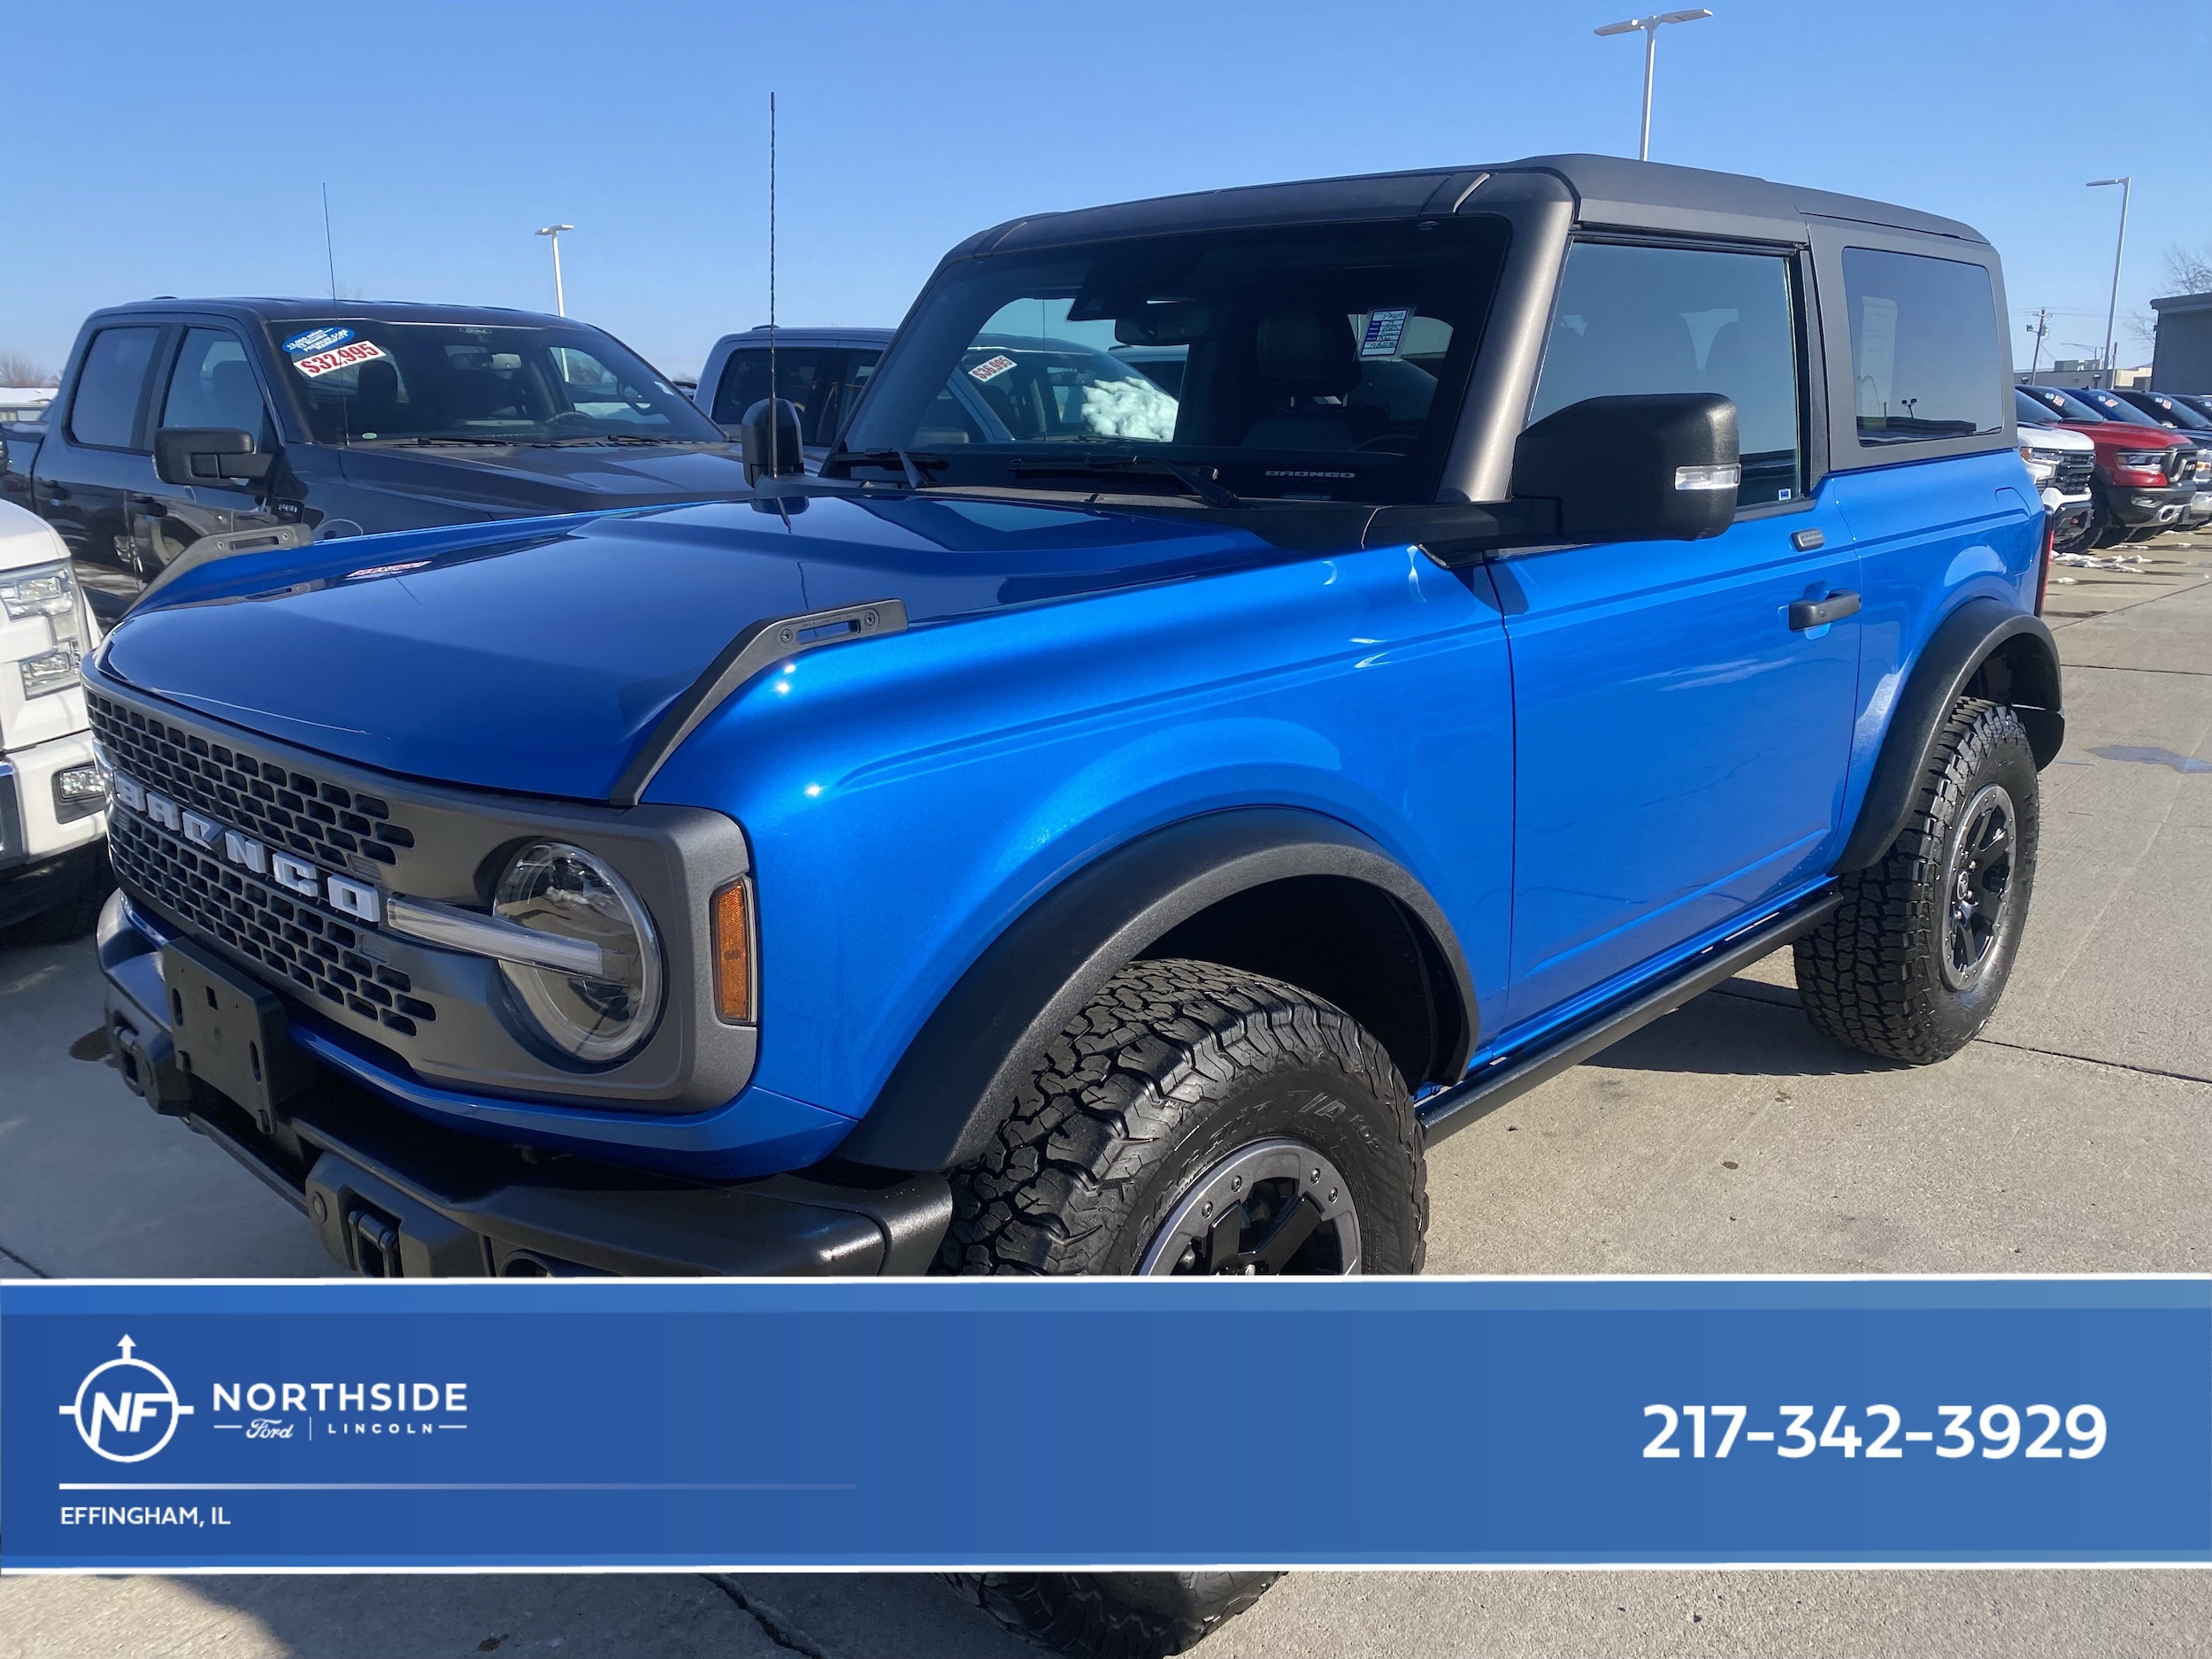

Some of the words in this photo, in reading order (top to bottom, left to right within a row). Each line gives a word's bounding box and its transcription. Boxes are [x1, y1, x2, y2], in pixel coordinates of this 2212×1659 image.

[300, 343, 380, 374] $32,995
[972, 356, 1014, 380] $36,995
[115, 772, 380, 922] BRONCO
